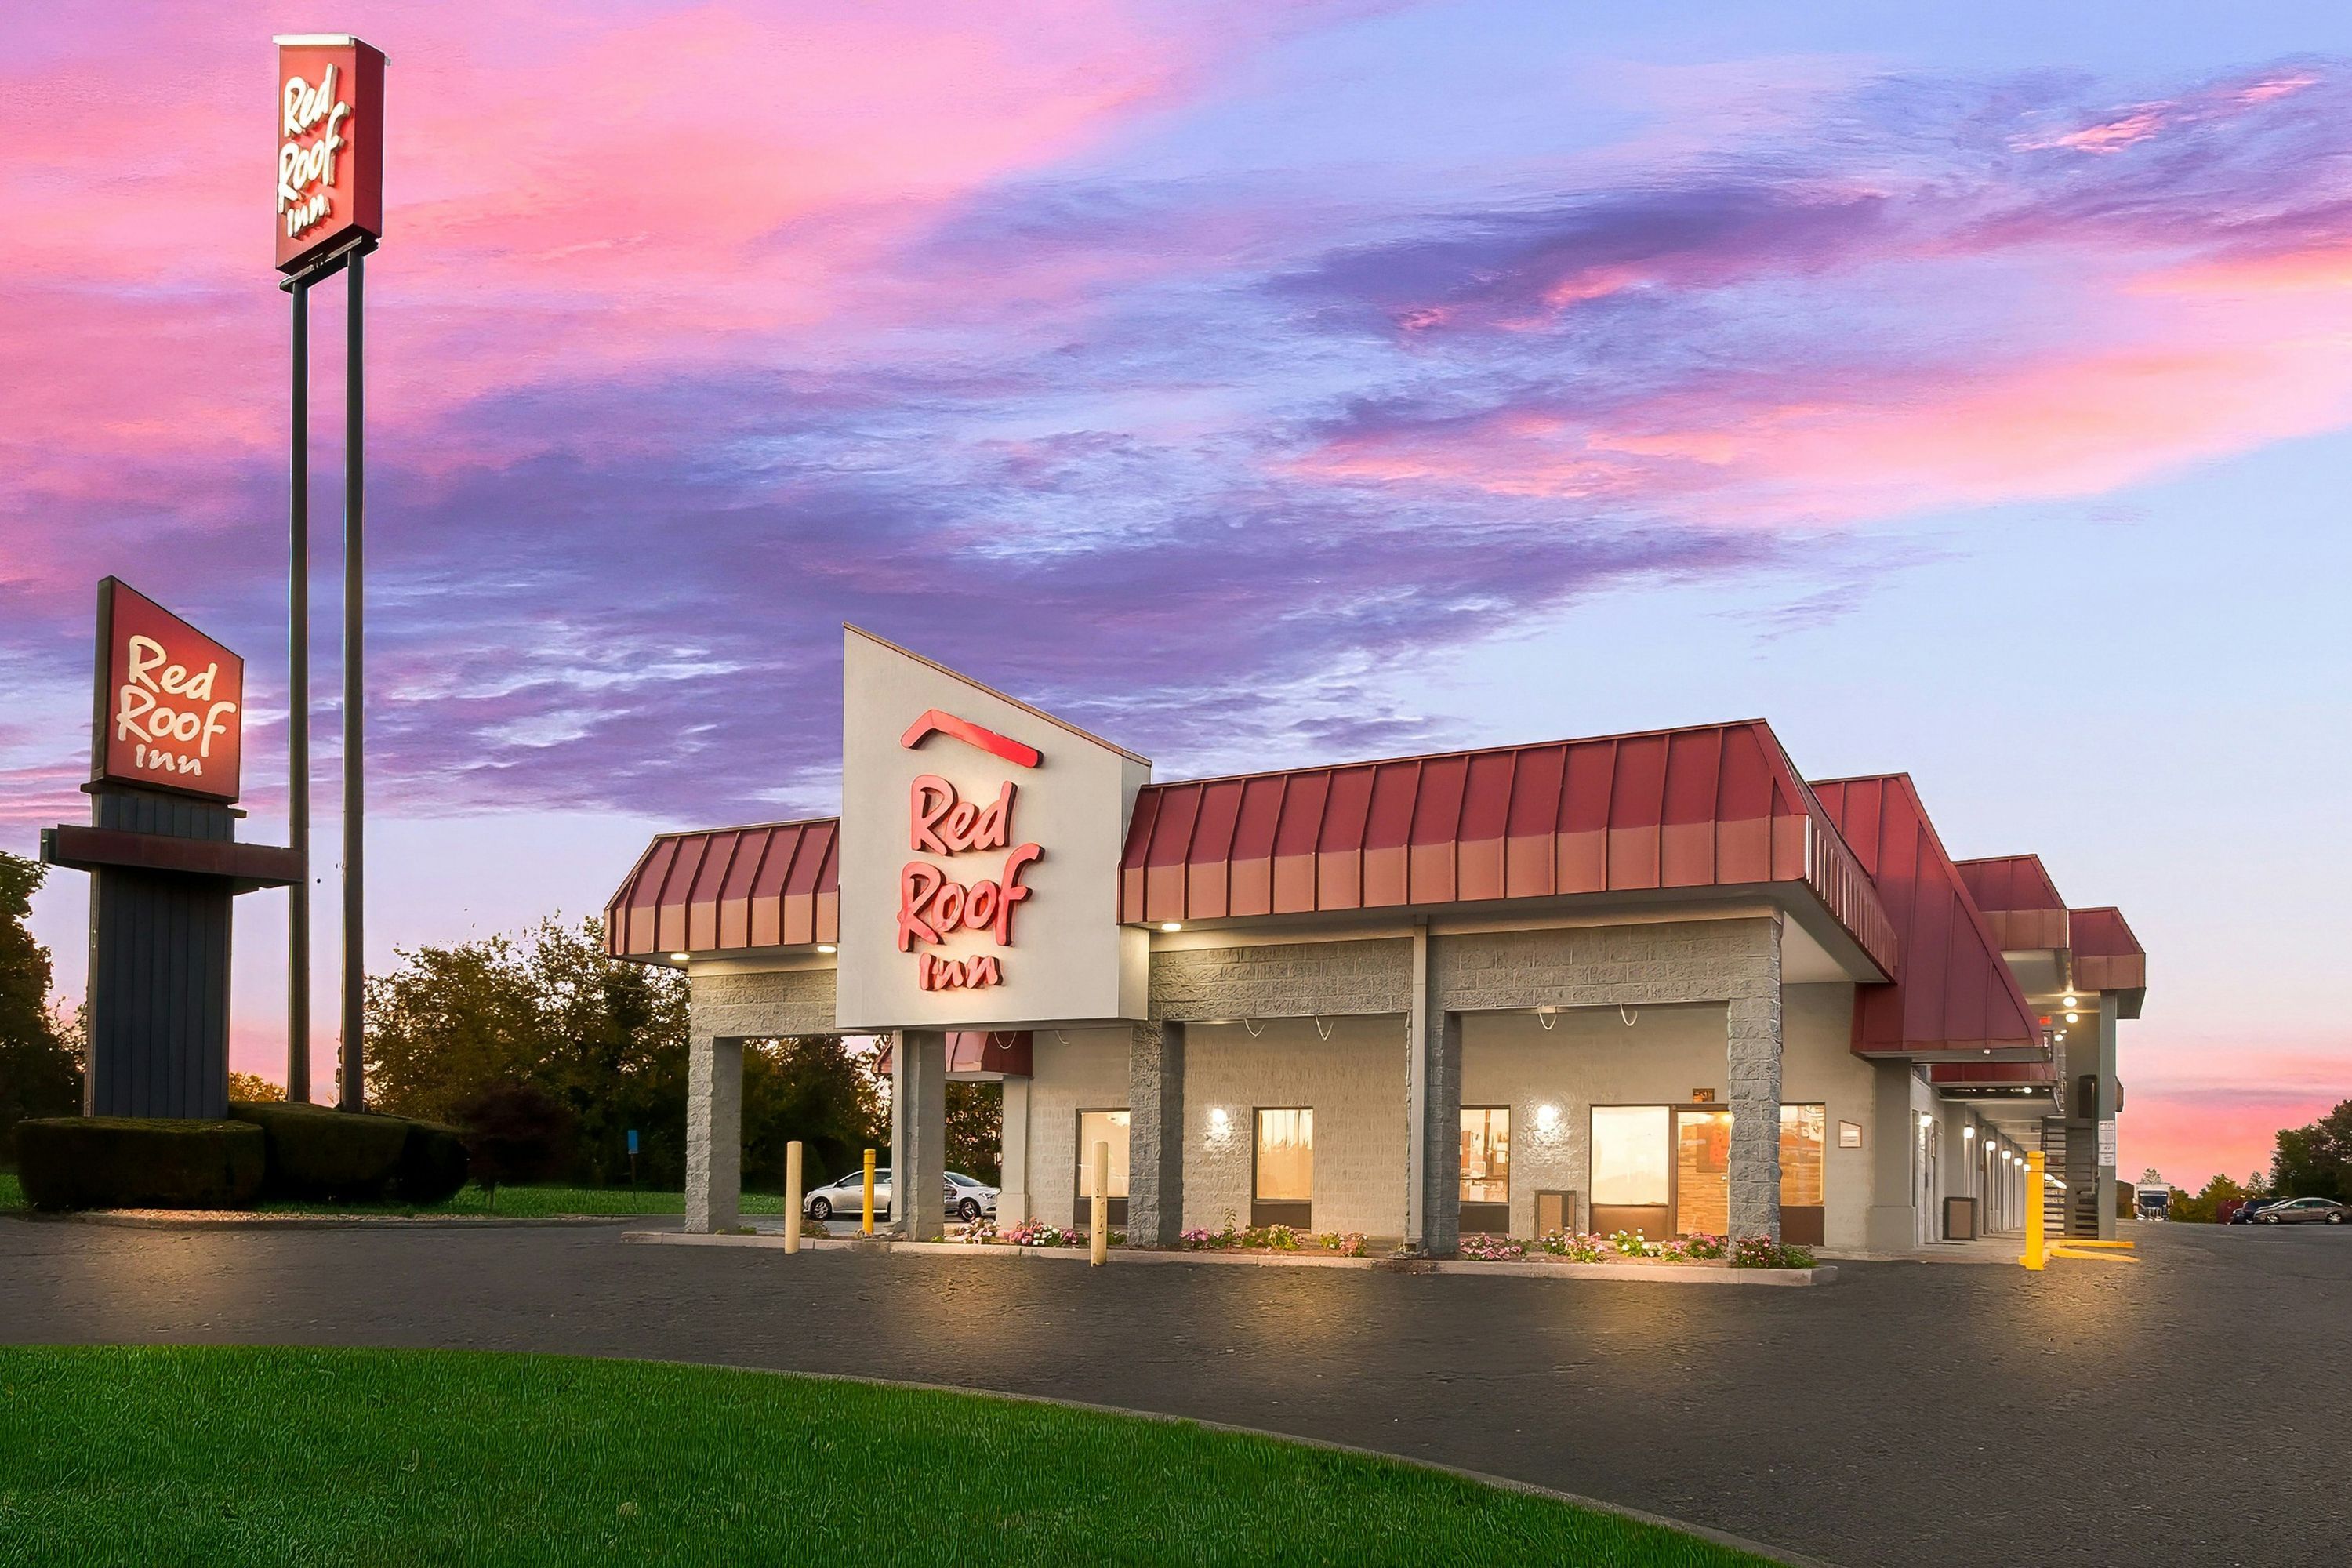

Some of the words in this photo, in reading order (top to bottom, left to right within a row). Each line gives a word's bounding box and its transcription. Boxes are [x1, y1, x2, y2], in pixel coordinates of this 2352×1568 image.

[283, 62, 338, 138] Red
[278, 100, 350, 214] Roof
[129, 634, 218, 701] Red
[116, 684, 237, 757] Roof
[911, 775, 1018, 857] Red
[897, 843, 1045, 953] Roof
